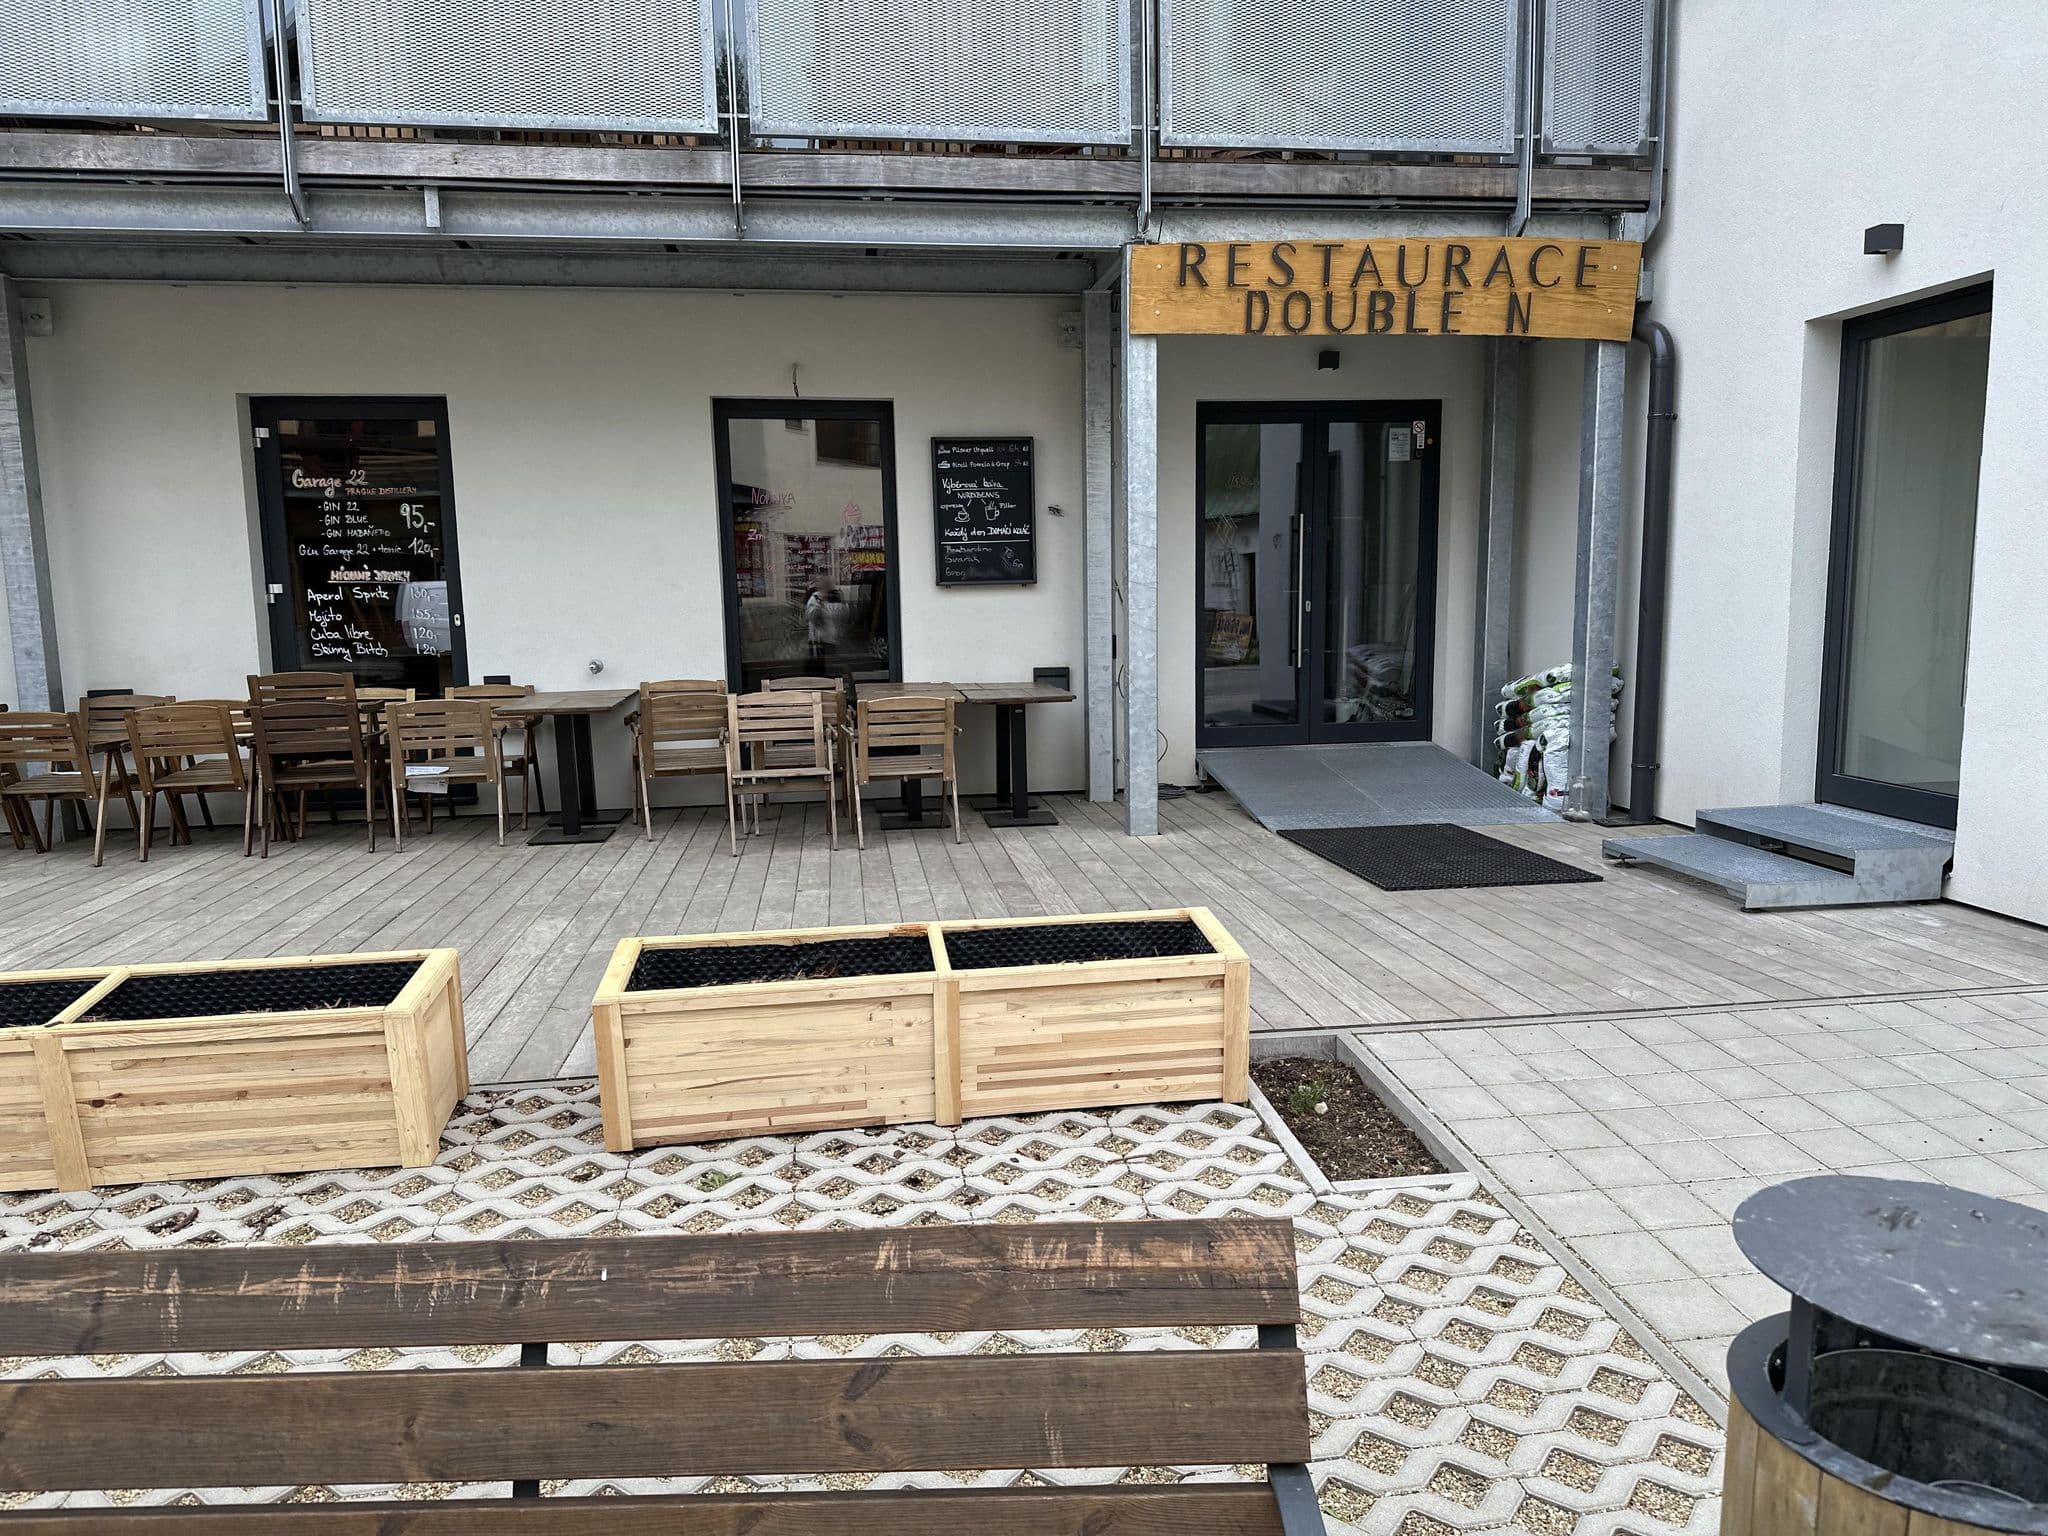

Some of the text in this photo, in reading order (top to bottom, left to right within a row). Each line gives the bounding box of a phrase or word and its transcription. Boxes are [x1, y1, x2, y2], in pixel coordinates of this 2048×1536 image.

[1180, 243, 1602, 289] RESTAURACE
[1245, 289, 1533, 336] DOUBLE N
[291, 469, 369, 498] Garage 22
[378, 486, 417, 495] DISTILLERY
[346, 501, 360, 511] 22
[345, 514, 369, 524] BLUE
[356, 543, 370, 555] 22
[307, 586, 344, 606] Aperol
[309, 607, 343, 627] Mojito
[310, 628, 345, 641] Cuba
[311, 643, 353, 663] Skinny
[352, 642, 389, 658] Bitch
